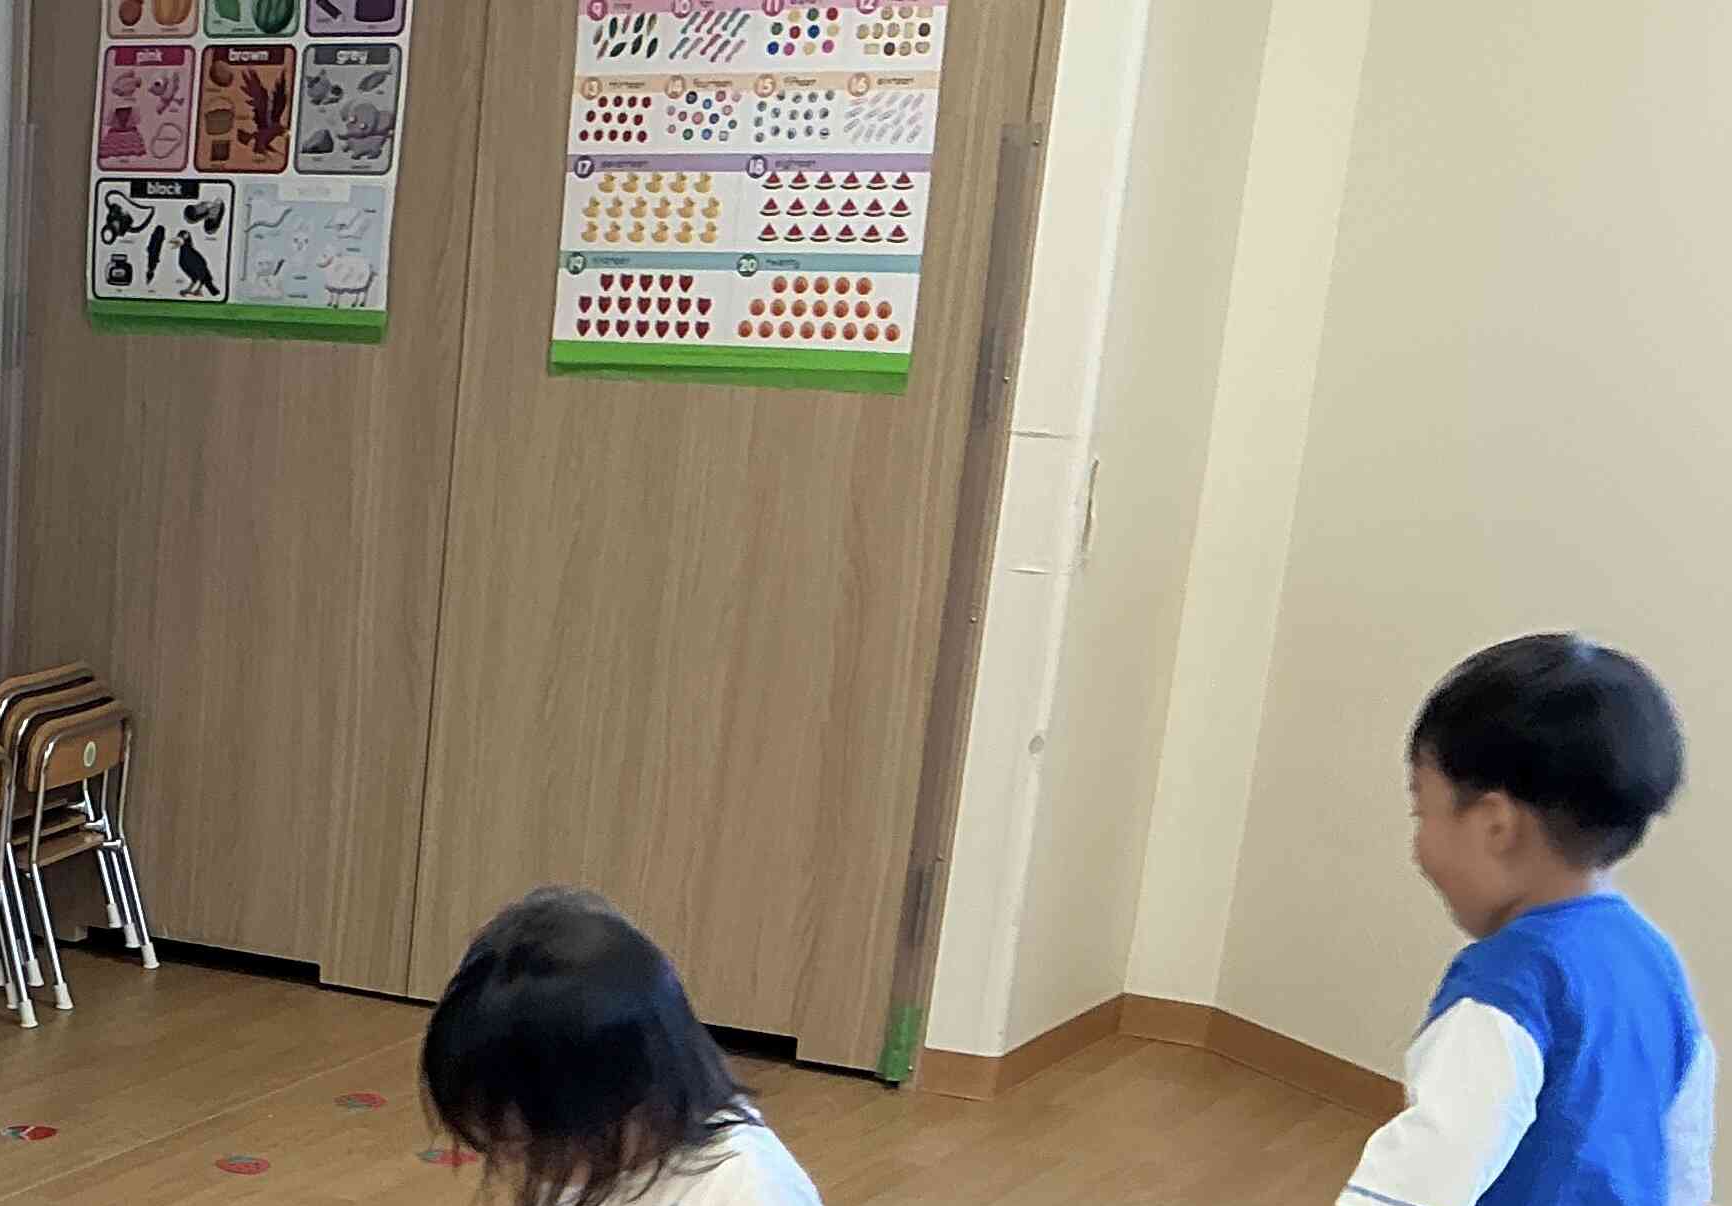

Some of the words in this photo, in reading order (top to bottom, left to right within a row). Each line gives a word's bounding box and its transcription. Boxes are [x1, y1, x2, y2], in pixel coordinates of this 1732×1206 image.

[228, 48, 269, 62] brown
[577, 160, 591, 175] 17
[146, 181, 183, 195] black
[739, 258, 757, 273] 20
